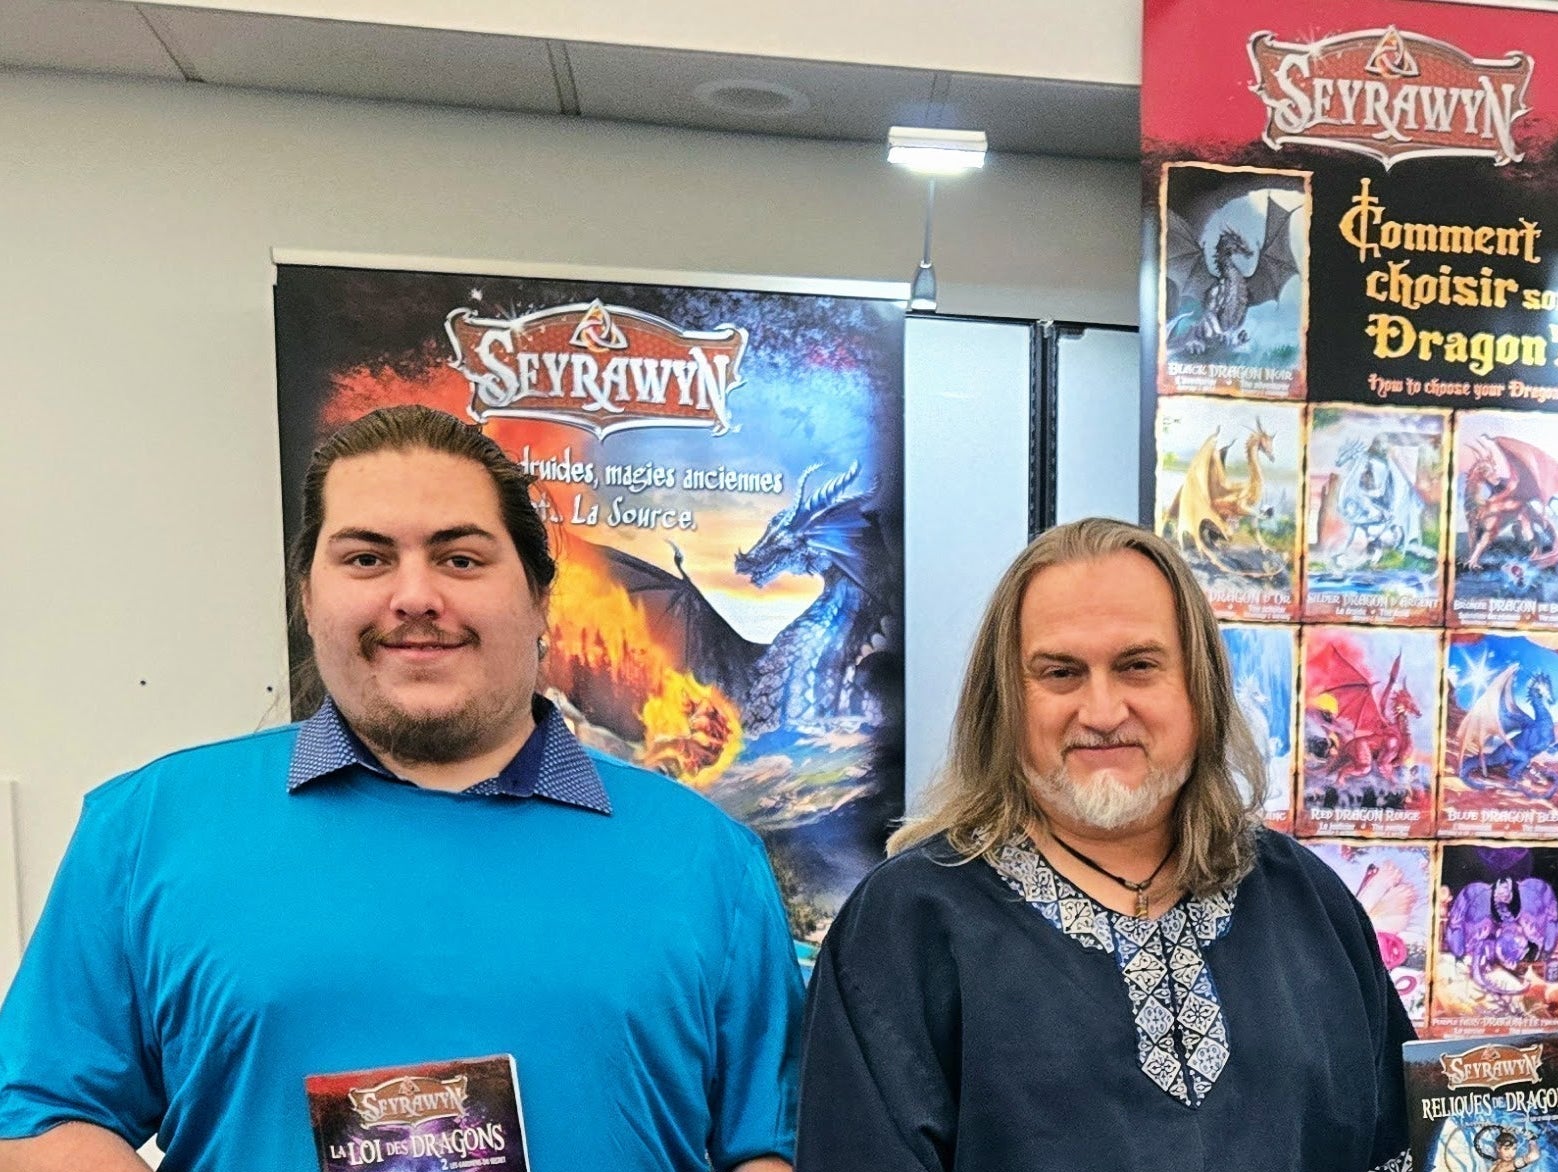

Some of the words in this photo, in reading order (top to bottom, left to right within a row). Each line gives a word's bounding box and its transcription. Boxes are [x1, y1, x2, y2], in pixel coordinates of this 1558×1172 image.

[1339, 178, 1541, 263] Comment
[1366, 260, 1519, 310] choisir
[1368, 373, 1403, 397] How
[1406, 377, 1421, 395] to
[1424, 377, 1470, 397] choose
[1473, 384, 1504, 399] your
[606, 463, 675, 493] magies
[683, 466, 783, 494] anciennes
[572, 494, 598, 525] La
[607, 496, 697, 531] Source.
[1489, 599, 1537, 613] DRAGON
[1311, 808, 1332, 821] RED
[1335, 808, 1383, 822] DRAGON
[1447, 810, 1478, 822] BLUE
[1481, 809, 1534, 823] DRAGON
[1422, 1092, 1492, 1121] RELIQUES
[330, 1145, 346, 1159] LA
[348, 1139, 384, 1166] LOI
[386, 1142, 409, 1156] DES
[410, 1123, 506, 1158] DRAGONS
[441, 1159, 449, 1170] 2
